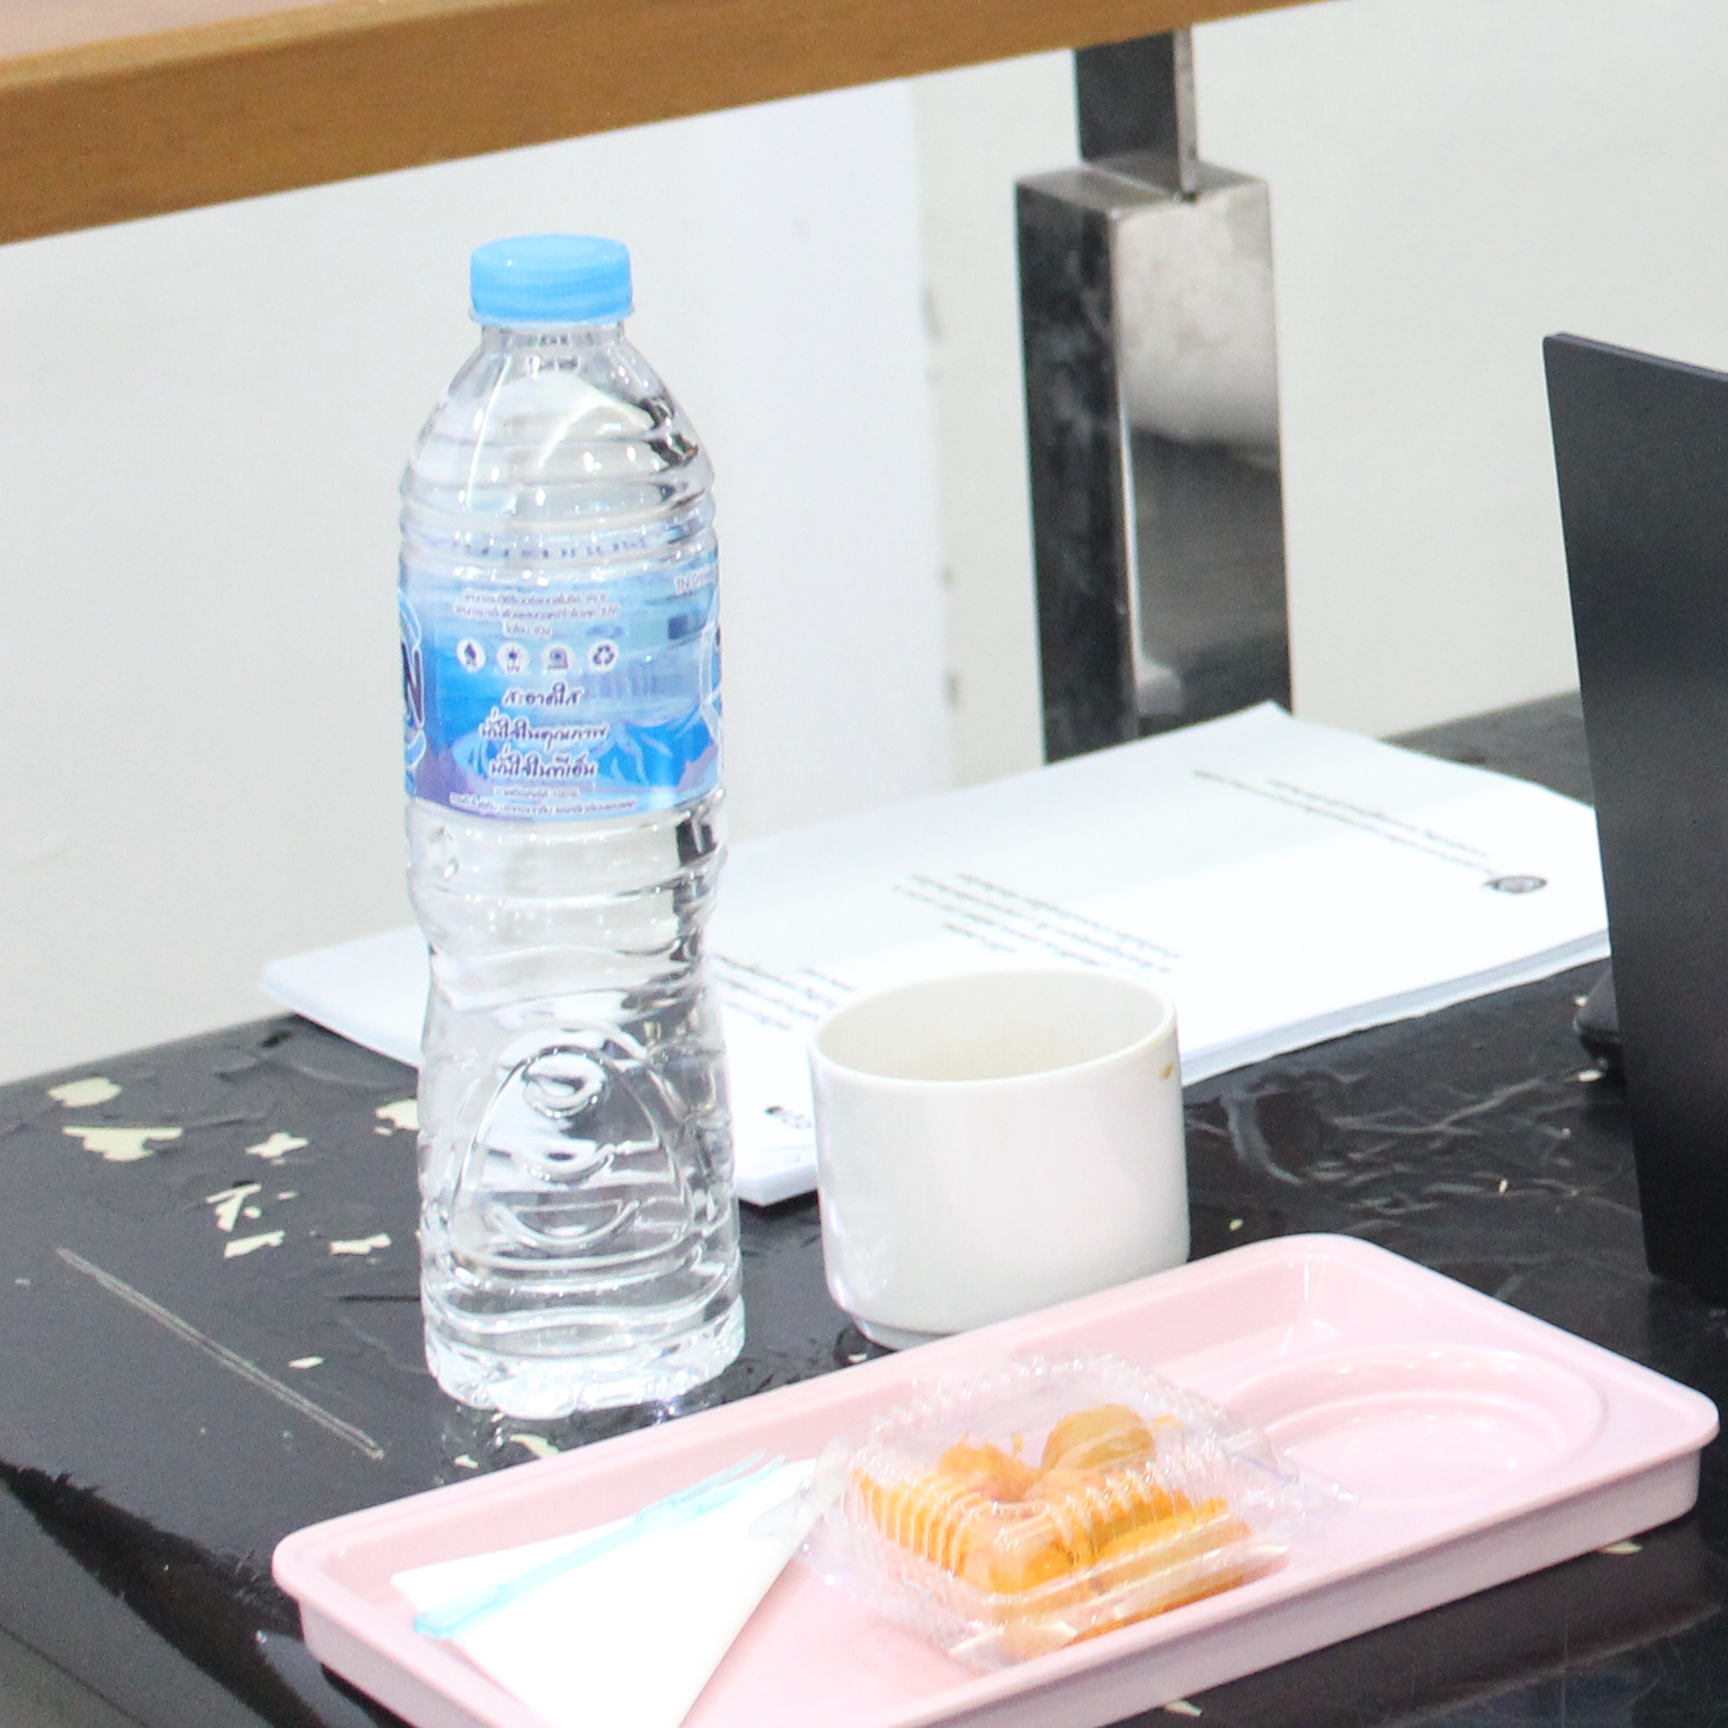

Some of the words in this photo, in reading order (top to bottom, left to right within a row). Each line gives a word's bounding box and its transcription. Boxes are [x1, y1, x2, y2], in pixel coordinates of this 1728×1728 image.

[502, 680, 584, 707] สะอาดใส
[480, 708, 608, 751] มั่นใจในคุณภาพ
